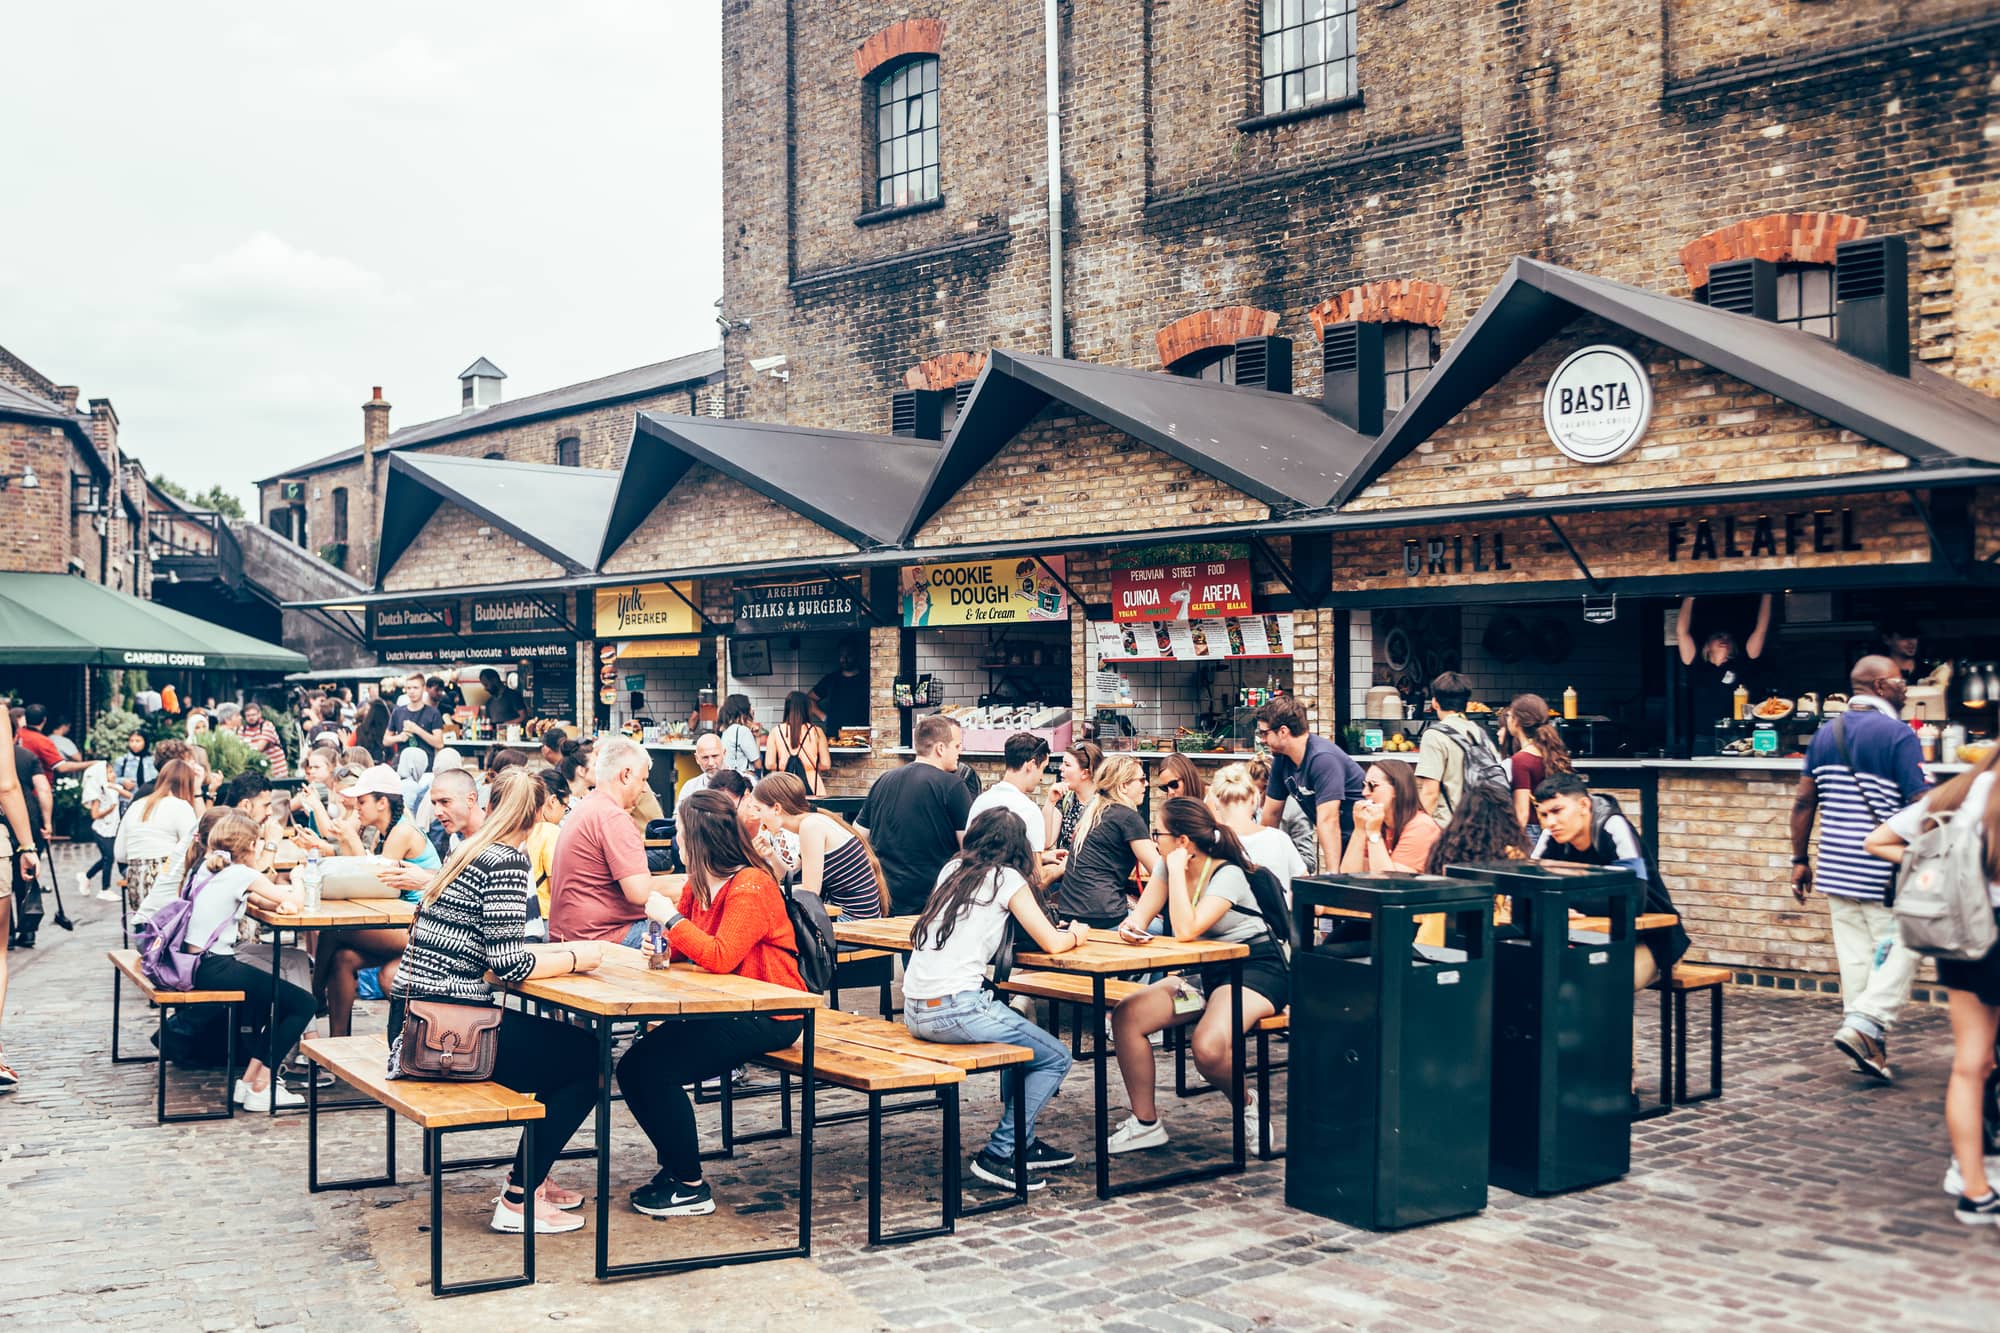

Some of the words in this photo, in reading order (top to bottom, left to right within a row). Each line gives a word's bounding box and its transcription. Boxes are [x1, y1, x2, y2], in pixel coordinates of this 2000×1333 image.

[1560, 382, 1631, 414] BASTA
[1668, 508, 1862, 561] FALAFEL
[1403, 534, 1511, 576] GRILL
[932, 566, 992, 587] COOKIE
[1131, 568, 1164, 581] PERUVIAN
[1172, 566, 1196, 579] STREET
[1207, 564, 1225, 576] FOOD
[767, 585, 824, 599] ARGENTINE
[951, 585, 1009, 605] DOUGH
[1123, 589, 1160, 608] QUINOA
[1202, 584, 1241, 602] AREPA
[741, 603, 784, 619] STEAKS
[787, 601, 795, 616] &
[798, 599, 851, 616] BURGERS
[975, 608, 988, 620] Ice
[989, 607, 1015, 620] Cream
[1226, 601, 1248, 610] HALAL
[378, 611, 403, 626] Dutch
[625, 612, 667, 625] BREAKER
[123, 652, 167, 664] CAMDEN
[168, 654, 206, 666] COFFEE
[404, 650, 433, 660] Pancakes
[439, 648, 465, 661] Belgian
[466, 647, 502, 658] Chocolate
[510, 646, 536, 657] Bubble
[537, 644, 567, 656] Waffles
